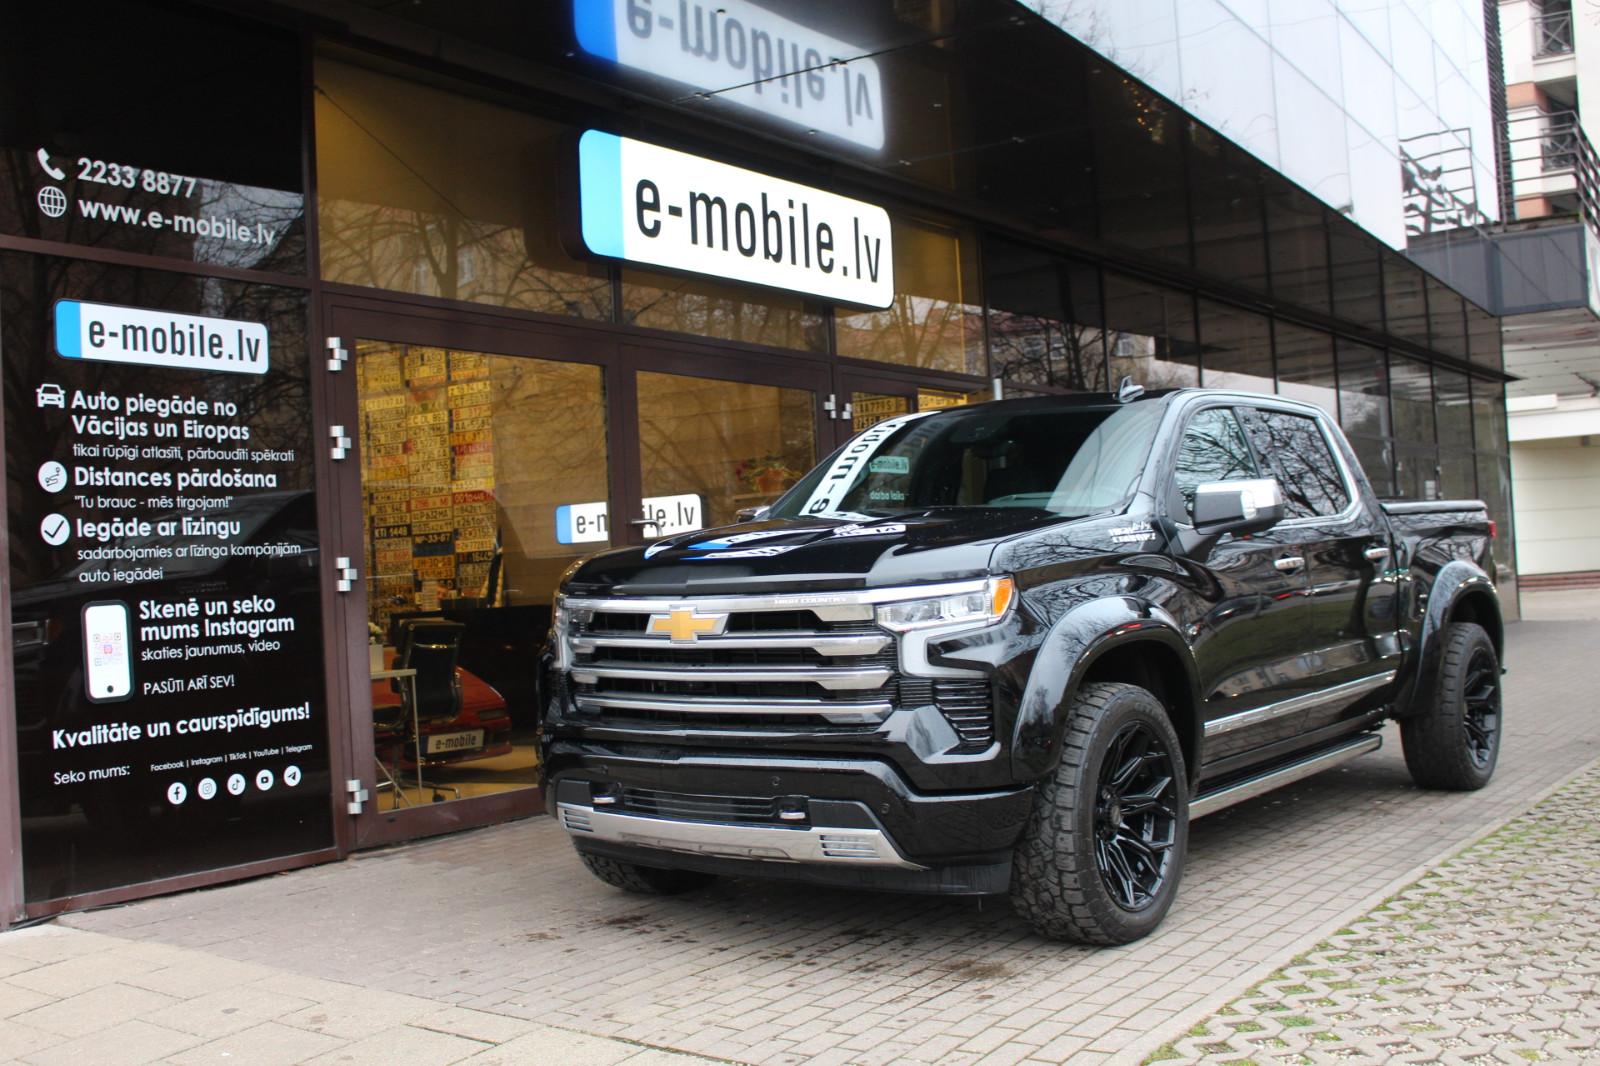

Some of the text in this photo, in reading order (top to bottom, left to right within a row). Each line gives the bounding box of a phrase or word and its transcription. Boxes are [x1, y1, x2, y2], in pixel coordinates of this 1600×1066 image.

[77, 157, 197, 198] 2233 8877
[78, 199, 275, 245] www.e-mobile.lv
[635, 178, 881, 284] e-mobile.lv
[88, 319, 261, 362] e-mobile.lv
[71, 390, 238, 418] Auto piegāde no
[72, 415, 250, 443] Vācijas un Eiropas
[73, 443, 295, 463] tikai rūpīgi atlasīti, pārbaudīti spēkrati
[75, 466, 277, 491] Distances pārdošana
[98, 495, 137, 509] brauc
[147, 495, 174, 509] mēs
[77, 516, 241, 541] Iegāde ar līzingu
[77, 541, 302, 561] sadarbojamies ar līzinga kompānijām
[79, 565, 163, 584] auto iegādei
[139, 594, 276, 620] Skenē un seko
[140, 616, 295, 642] mums Instagram
[141, 639, 280, 661] skaties jaunumus, video
[143, 674, 235, 695] PASŪTI ARĪ SEV!
[52, 701, 311, 750] Kvalitāte un caurspīdīgums!
[435, 730, 477, 750] e-mobile
[150, 761, 185, 772] Facebook
[190, 755, 223, 768] Instagram
[229, 752, 247, 761] TikTok
[253, 747, 279, 758] YouTube
[285, 743, 312, 754] Telegram
[54, 765, 131, 785] Seko mums:
